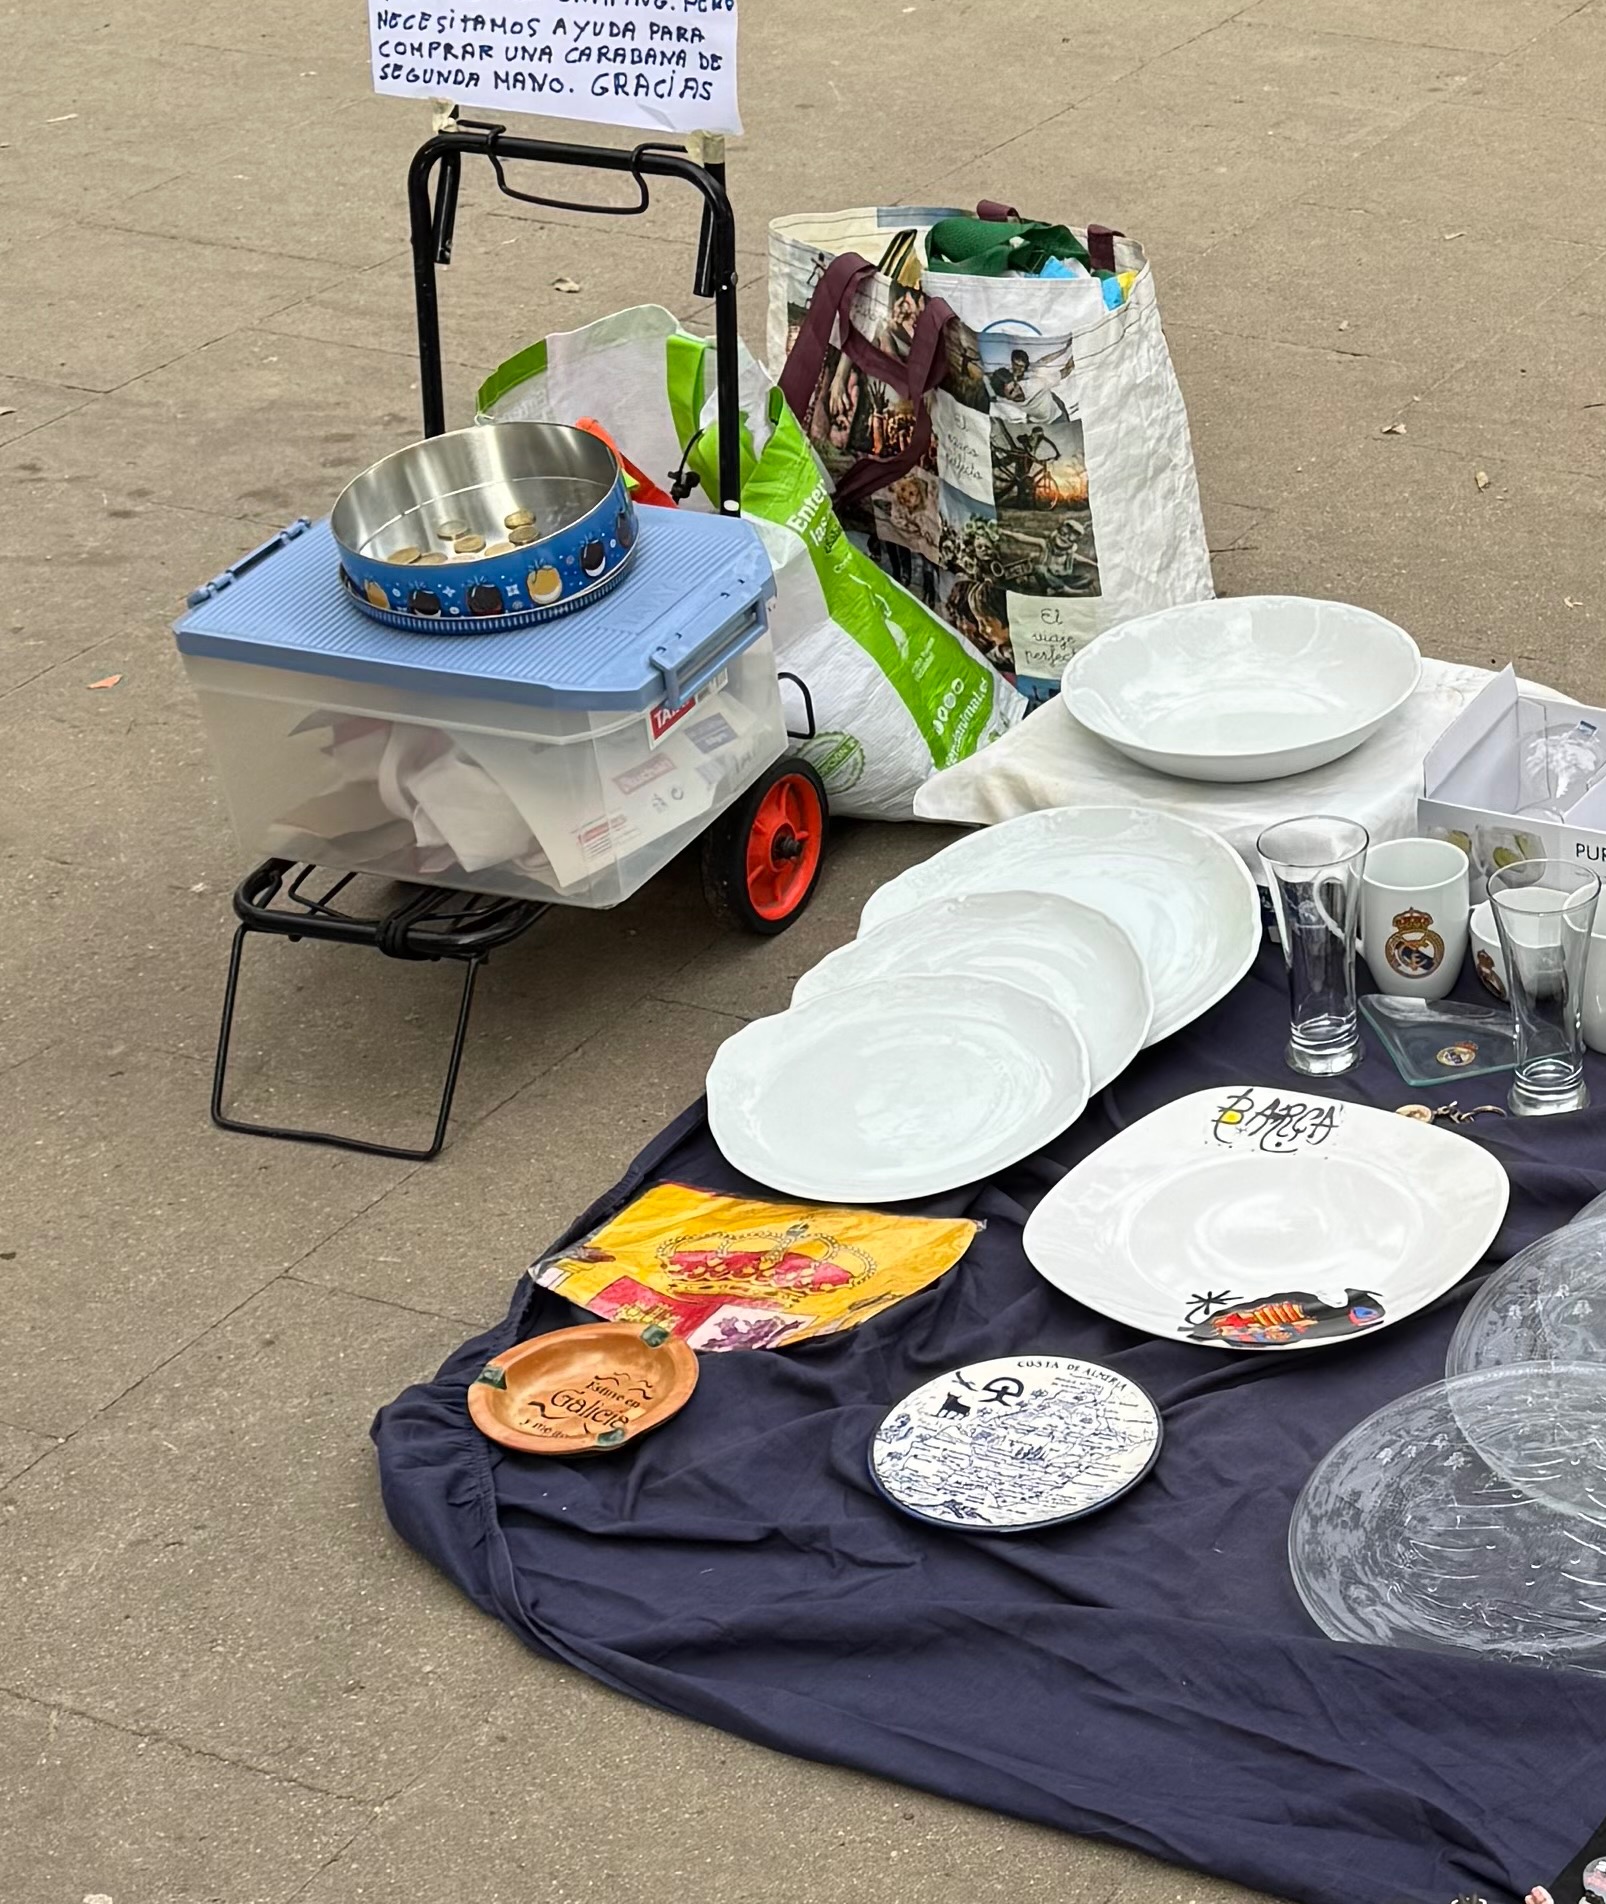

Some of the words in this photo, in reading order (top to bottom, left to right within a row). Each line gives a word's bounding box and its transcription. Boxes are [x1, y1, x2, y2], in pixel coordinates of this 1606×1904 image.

[376, 9, 541, 37] NECESITAMOS
[552, 18, 636, 43] AYUDA
[649, 24, 705, 44] PARA
[378, 40, 493, 61] COMPRAR
[505, 45, 553, 65] UNA
[564, 45, 687, 70] CARABANA
[698, 51, 723, 72] DE
[379, 63, 480, 88] SEGUNDA
[493, 72, 574, 94] MANO.
[590, 69, 713, 101] GRACIAS
[1040, 608, 1063, 625] El
